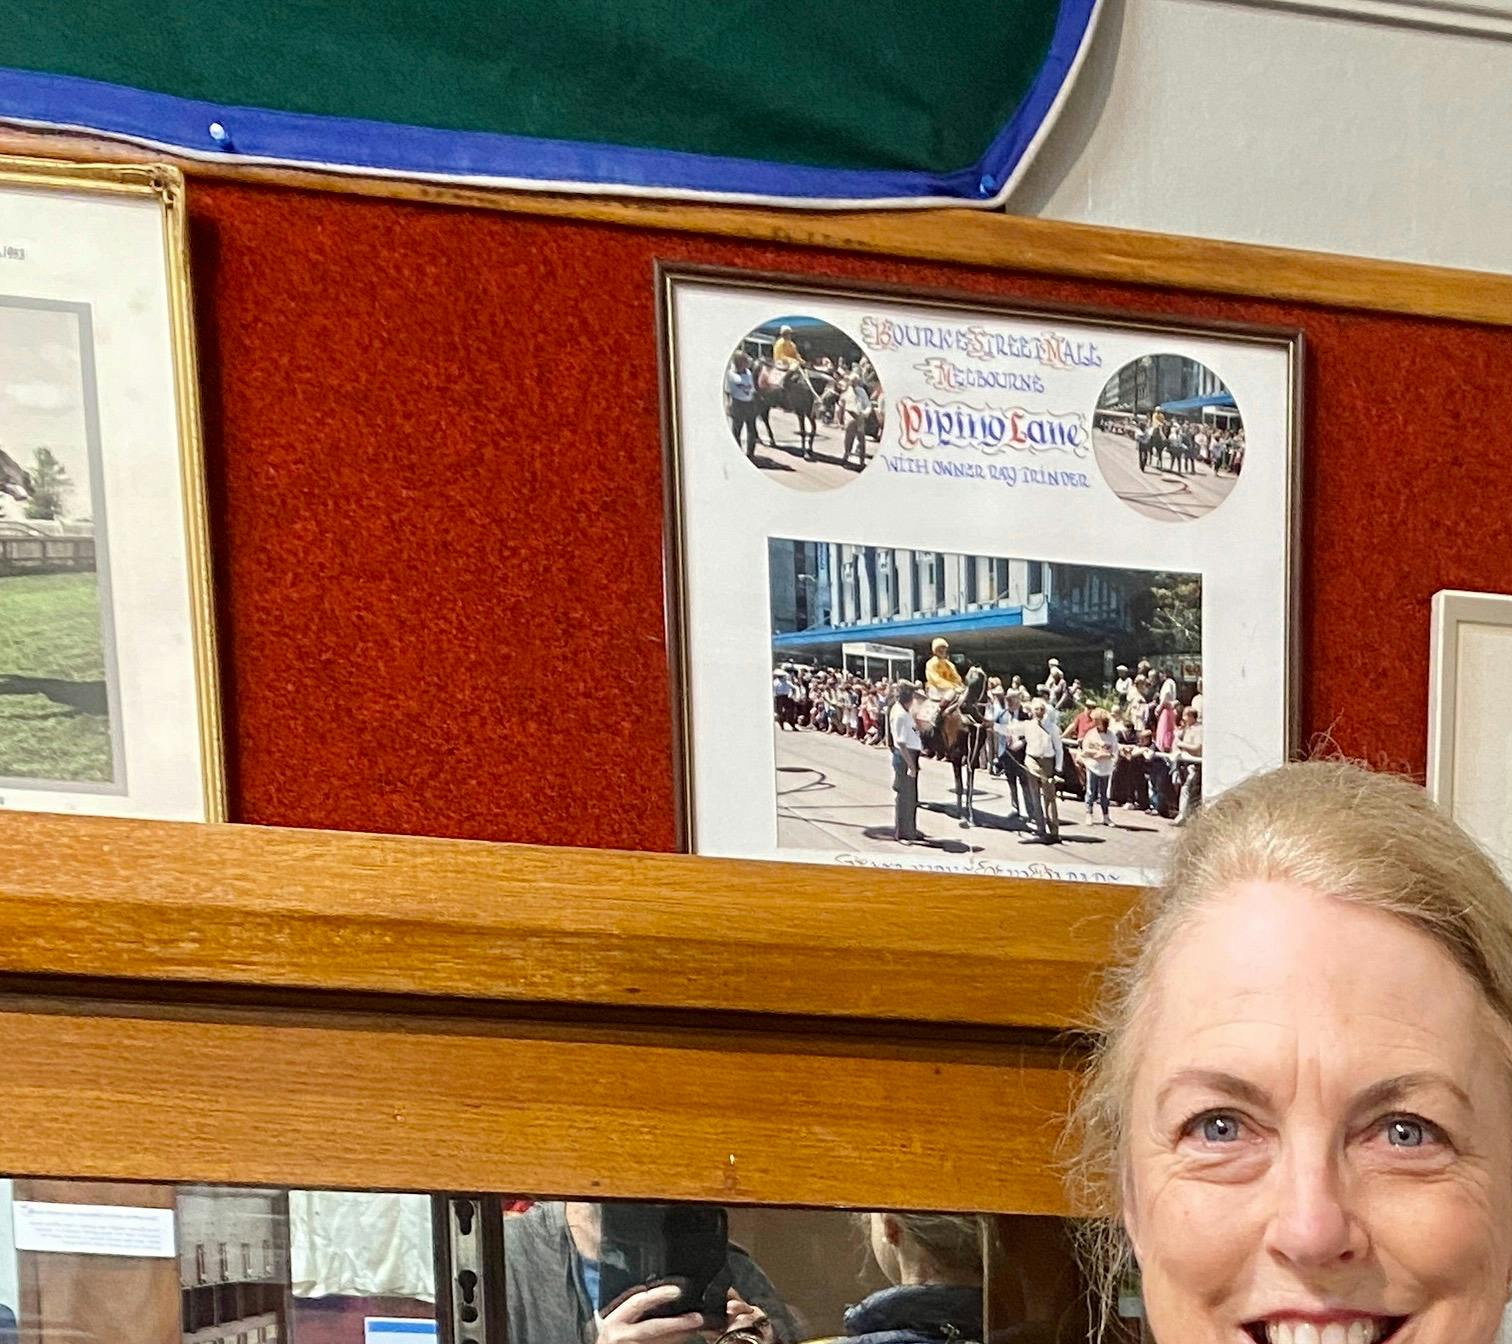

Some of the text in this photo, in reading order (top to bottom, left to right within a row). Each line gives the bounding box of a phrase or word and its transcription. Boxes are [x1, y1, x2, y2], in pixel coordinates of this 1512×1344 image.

[903, 402, 1081, 446] Piping Lane
[880, 454, 930, 474] WITH
[932, 461, 985, 480] OWNER
[1022, 466, 1090, 488] TRINDER
